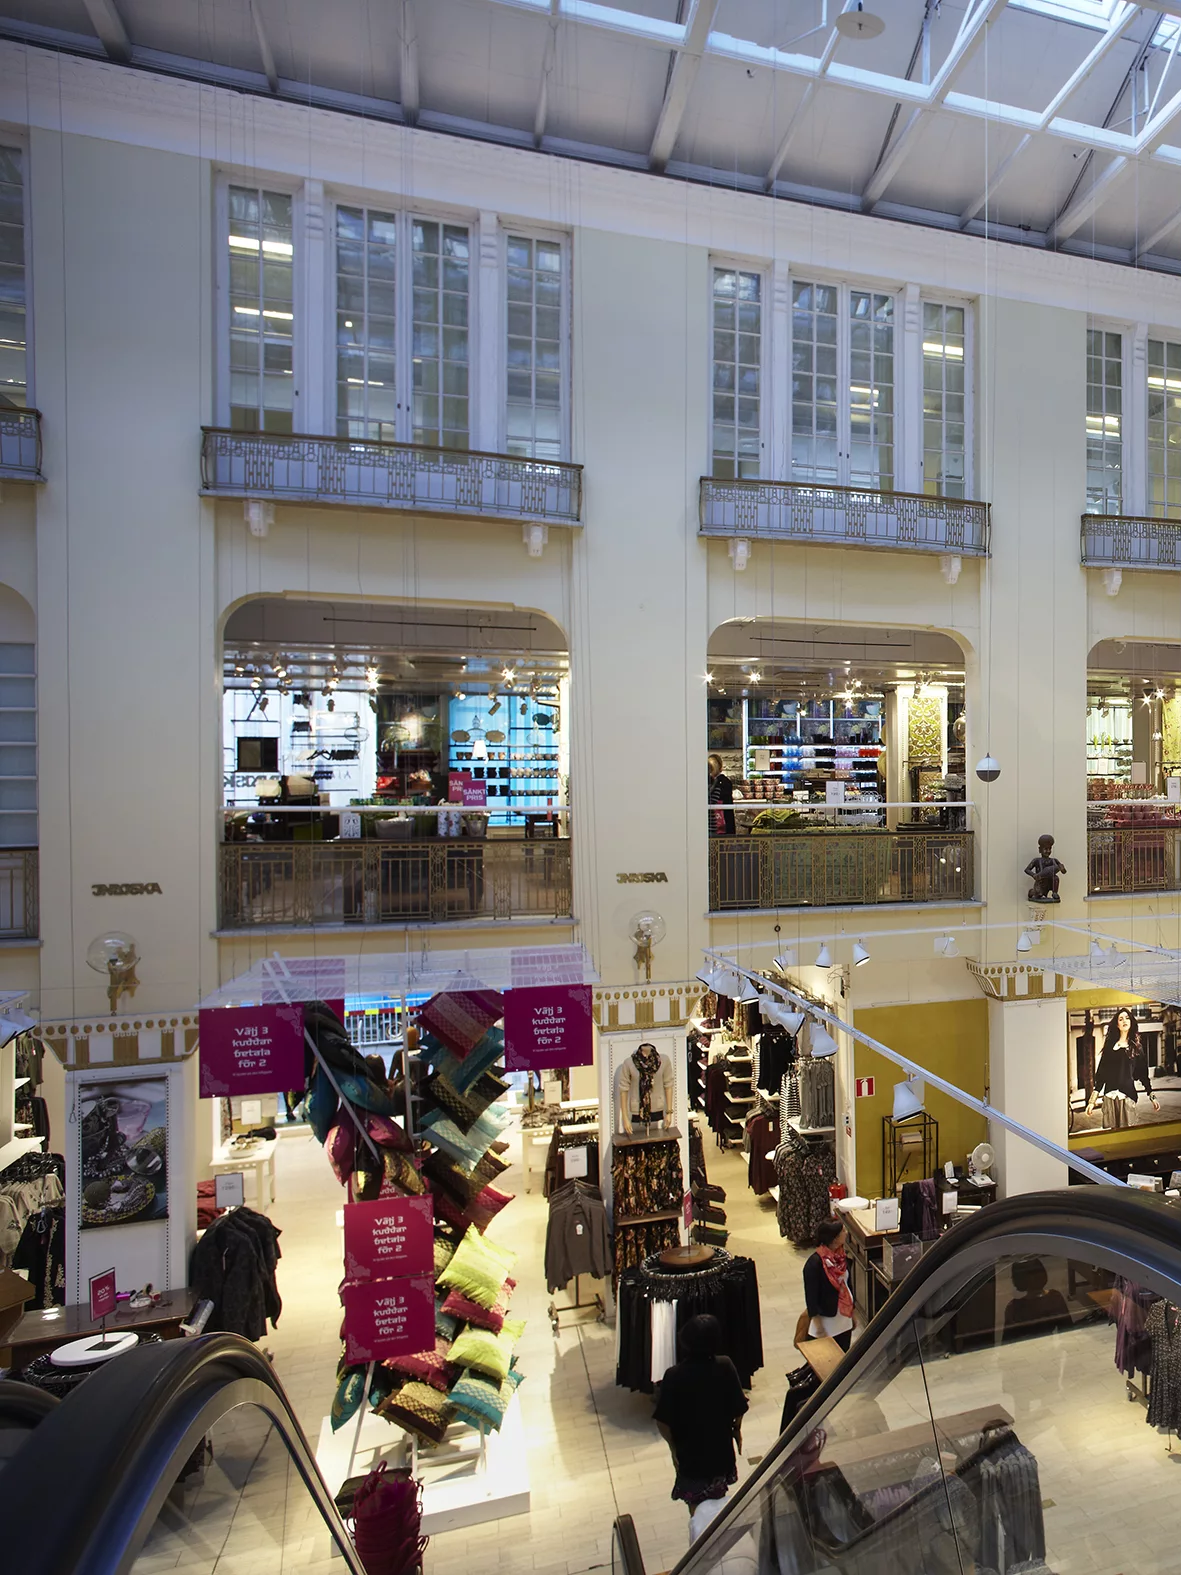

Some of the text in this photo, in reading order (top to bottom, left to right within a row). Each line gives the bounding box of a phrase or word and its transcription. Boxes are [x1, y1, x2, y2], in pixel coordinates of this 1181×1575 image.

[532, 1017, 566, 1025] kuddar
[234, 1026, 258, 1036] Välj
[533, 1027, 564, 1035] betala
[232, 1038, 272, 1047] kuddar
[234, 1048, 271, 1058] betala
[238, 1059, 266, 1068] för 2
[372, 1226, 407, 1236] kuddar
[374, 1236, 406, 1245] betala
[378, 1246, 393, 1254] för
[373, 1307, 408, 1316] kuddar
[375, 1316, 407, 1326] betala
[379, 1327, 394, 1335] för
